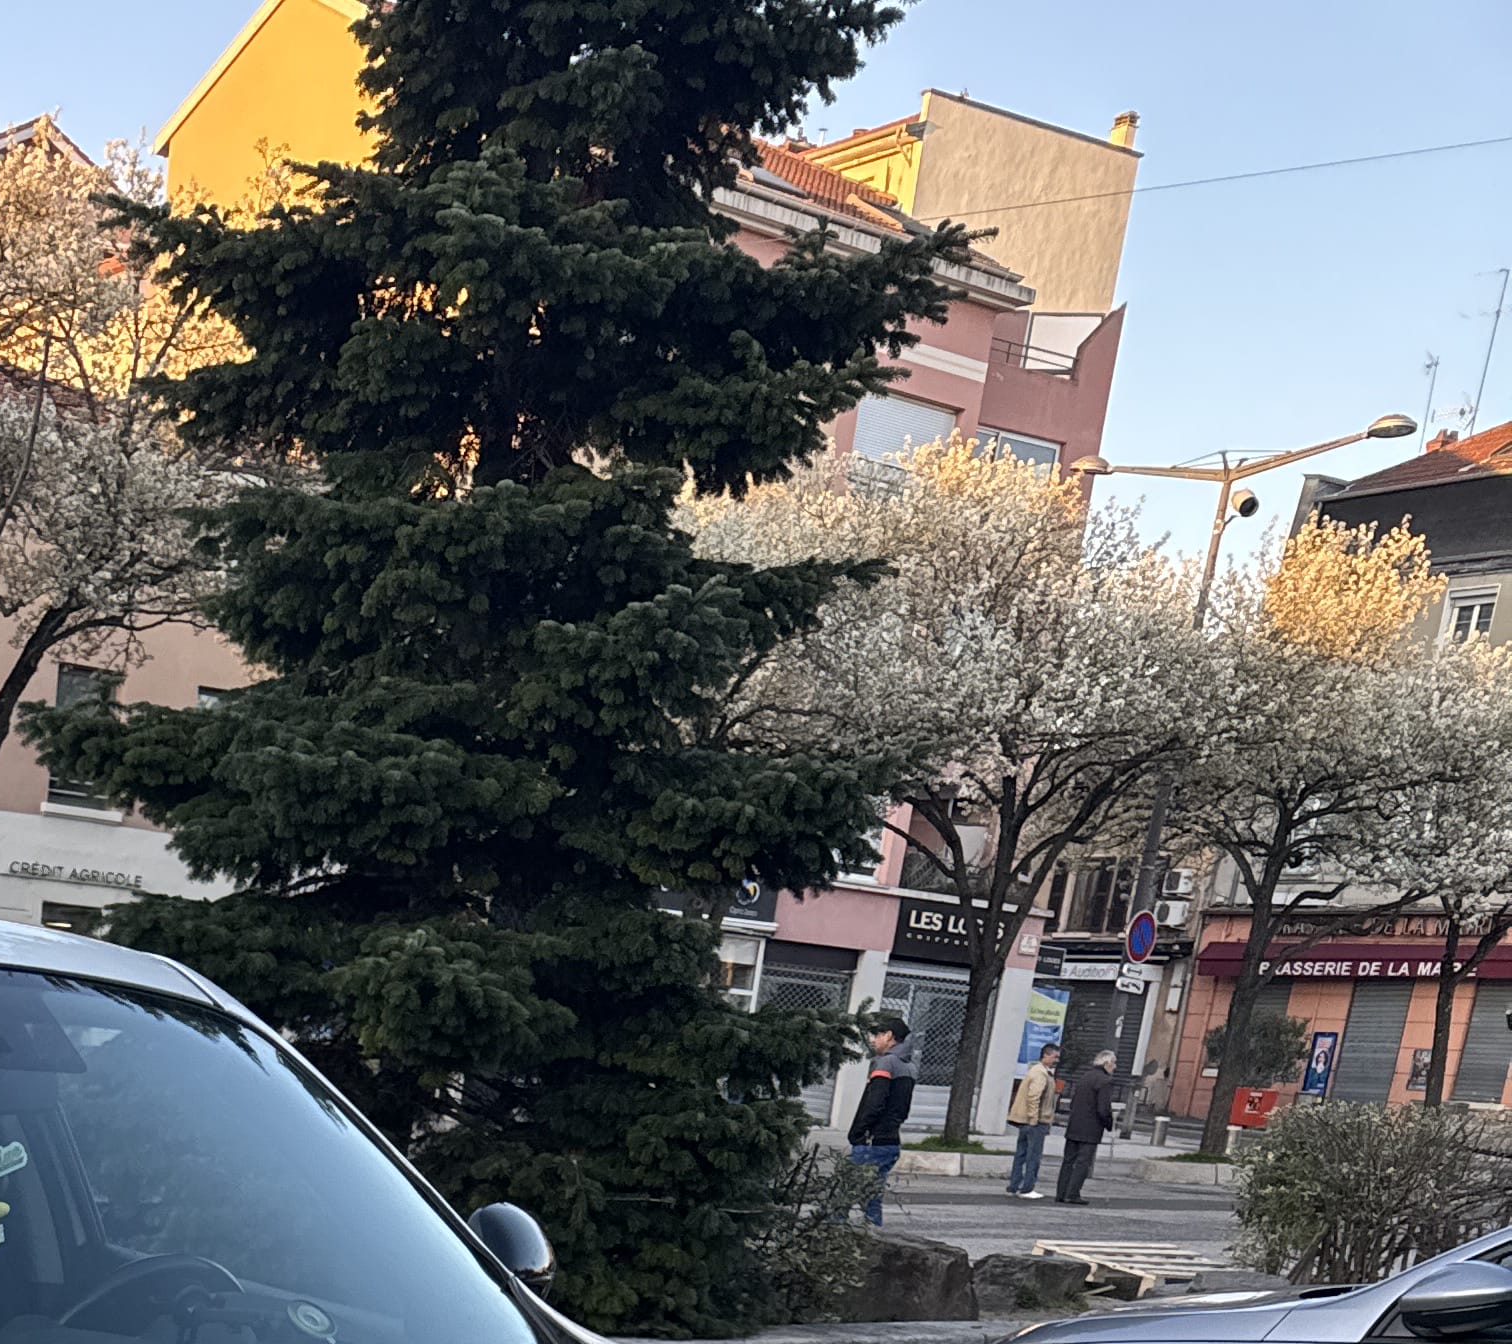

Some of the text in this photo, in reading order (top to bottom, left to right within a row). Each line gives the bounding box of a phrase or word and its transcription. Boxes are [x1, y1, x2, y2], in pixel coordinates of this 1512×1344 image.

[68, 868, 143, 888] AGRICOLE
[909, 910, 944, 931] LES
[1403, 917, 1425, 935] LA
[1258, 961, 1352, 976] BASSERIE
[1357, 962, 1383, 976] DE
[1387, 962, 1410, 976] LA
